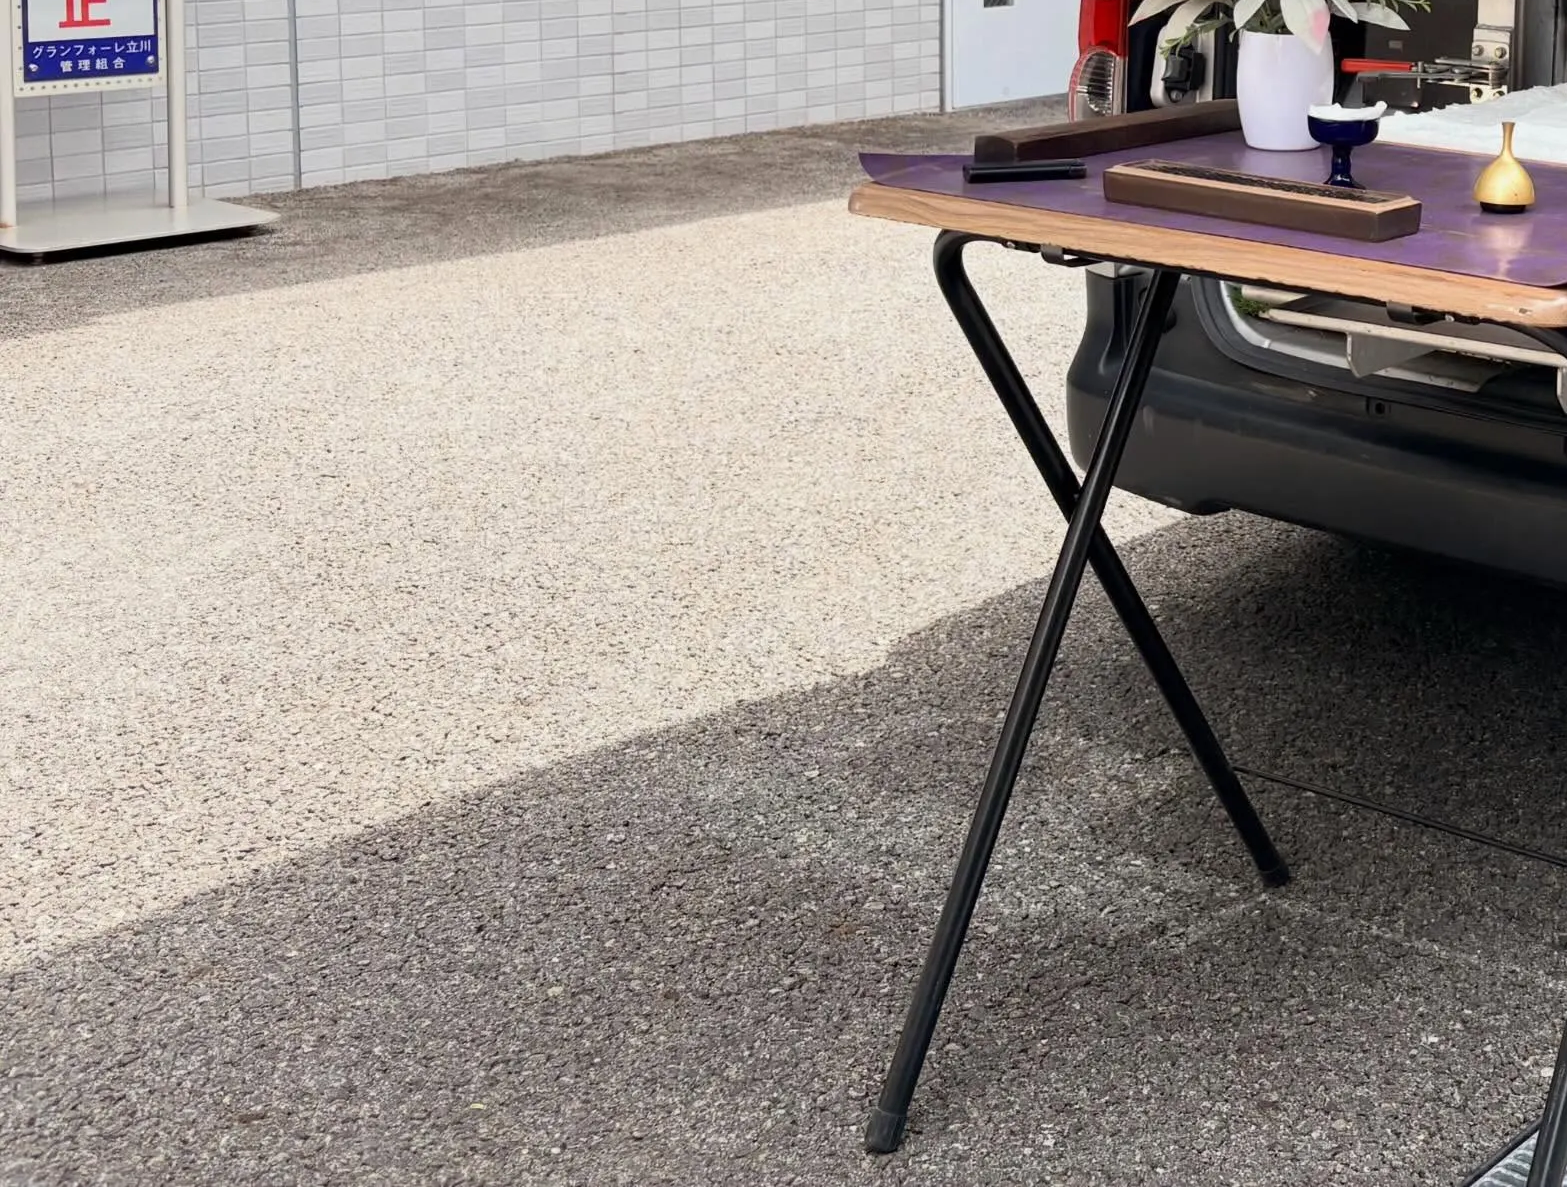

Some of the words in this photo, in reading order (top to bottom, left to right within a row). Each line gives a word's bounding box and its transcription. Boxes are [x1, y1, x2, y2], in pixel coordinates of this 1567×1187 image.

[32, 39, 151, 59] グランフォーレ立川
[60, 56, 126, 73] 管理組合
